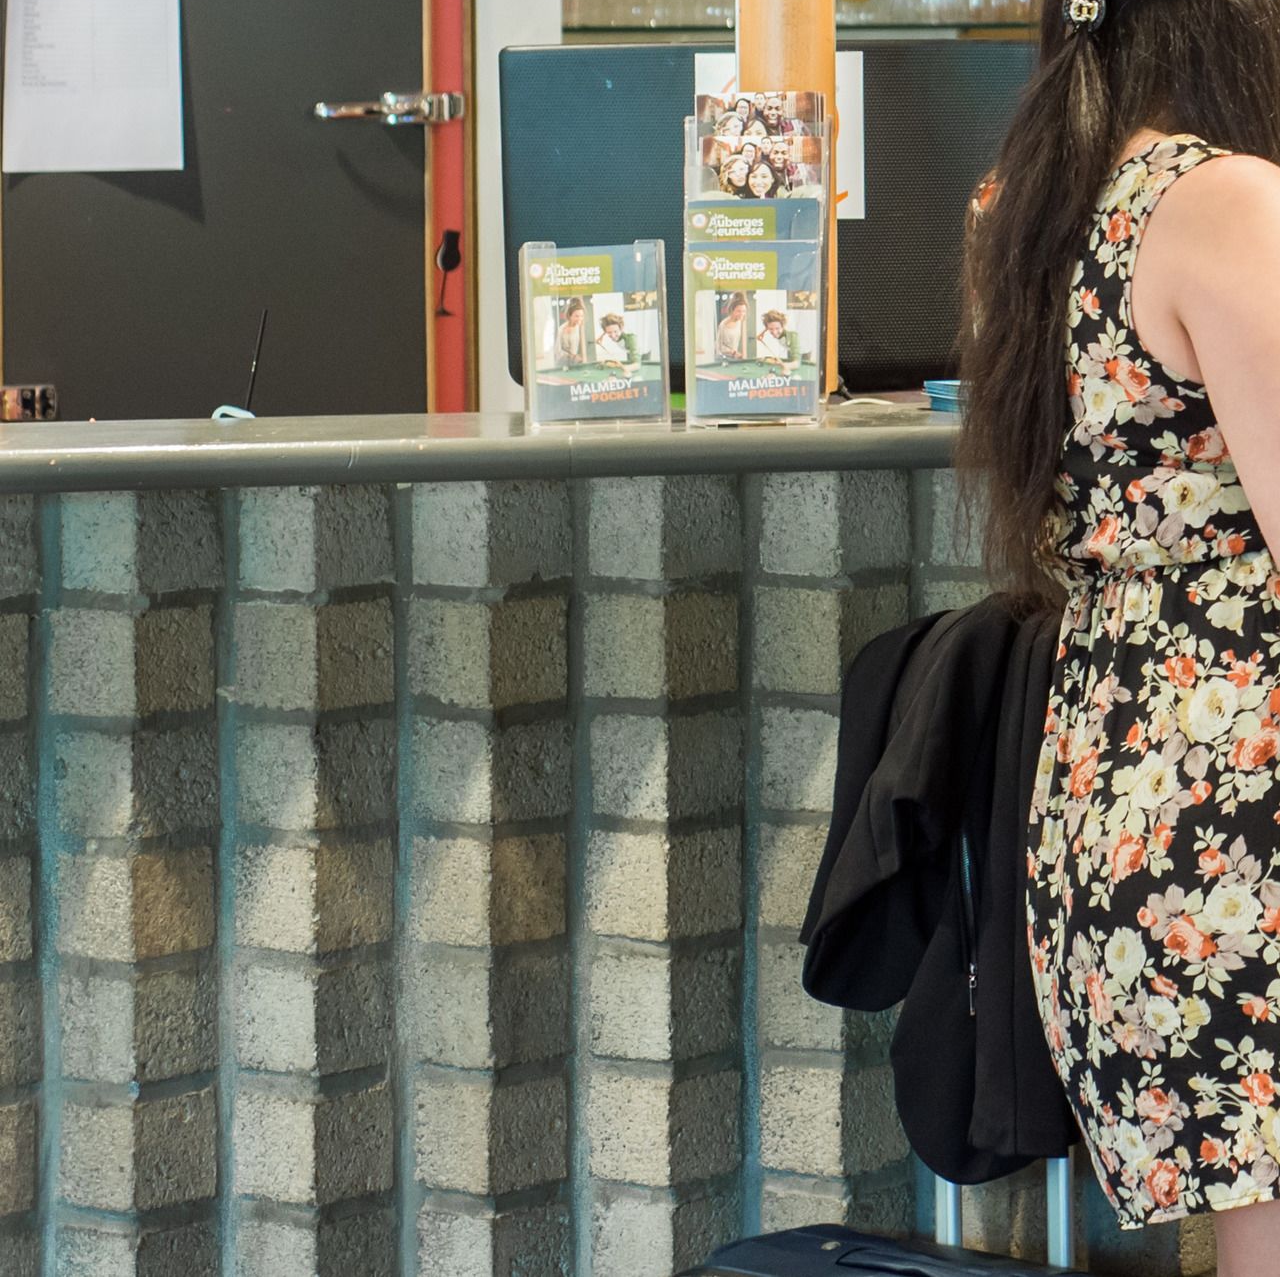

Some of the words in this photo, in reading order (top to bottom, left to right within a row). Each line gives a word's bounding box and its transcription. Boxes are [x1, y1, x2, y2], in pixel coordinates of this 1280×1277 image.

[708, 214, 764, 228] Auberges
[712, 225, 764, 236] Jeunesse
[545, 264, 601, 278] Auberges
[710, 258, 766, 271] Auberges
[713, 269, 766, 280] Jeunesse
[570, 377, 633, 396] MALMEDY
[728, 376, 792, 392] MALMEDY
[591, 386, 640, 403] POCKET
[748, 386, 798, 401] POCKET
